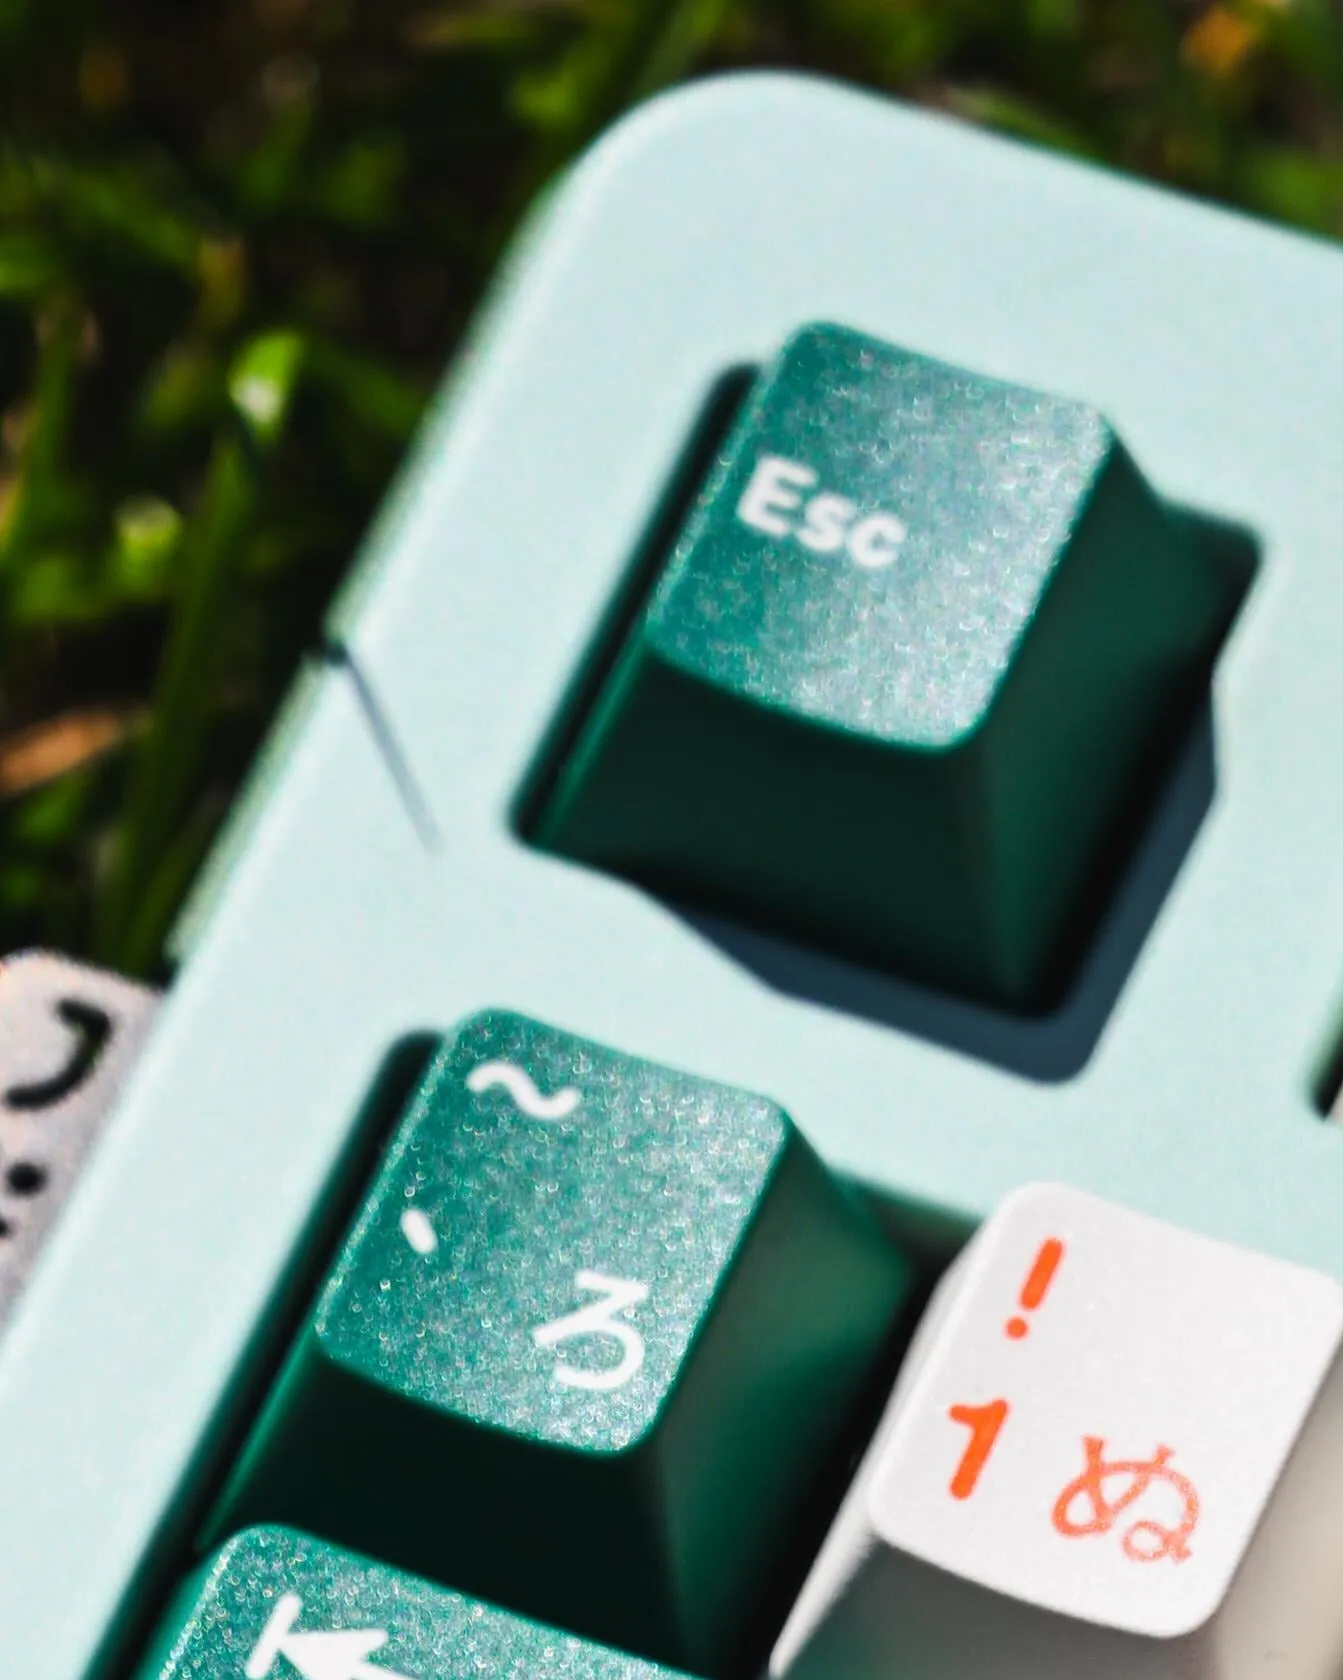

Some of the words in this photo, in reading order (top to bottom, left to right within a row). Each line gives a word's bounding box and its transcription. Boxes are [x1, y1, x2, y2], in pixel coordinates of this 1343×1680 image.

[737, 455, 906, 571] Esc
[532, 1268, 651, 1393] ろ
[1003, 1235, 1066, 1342] !
[946, 1396, 1012, 1502] 1
[1050, 1434, 1199, 1560] ぬ
